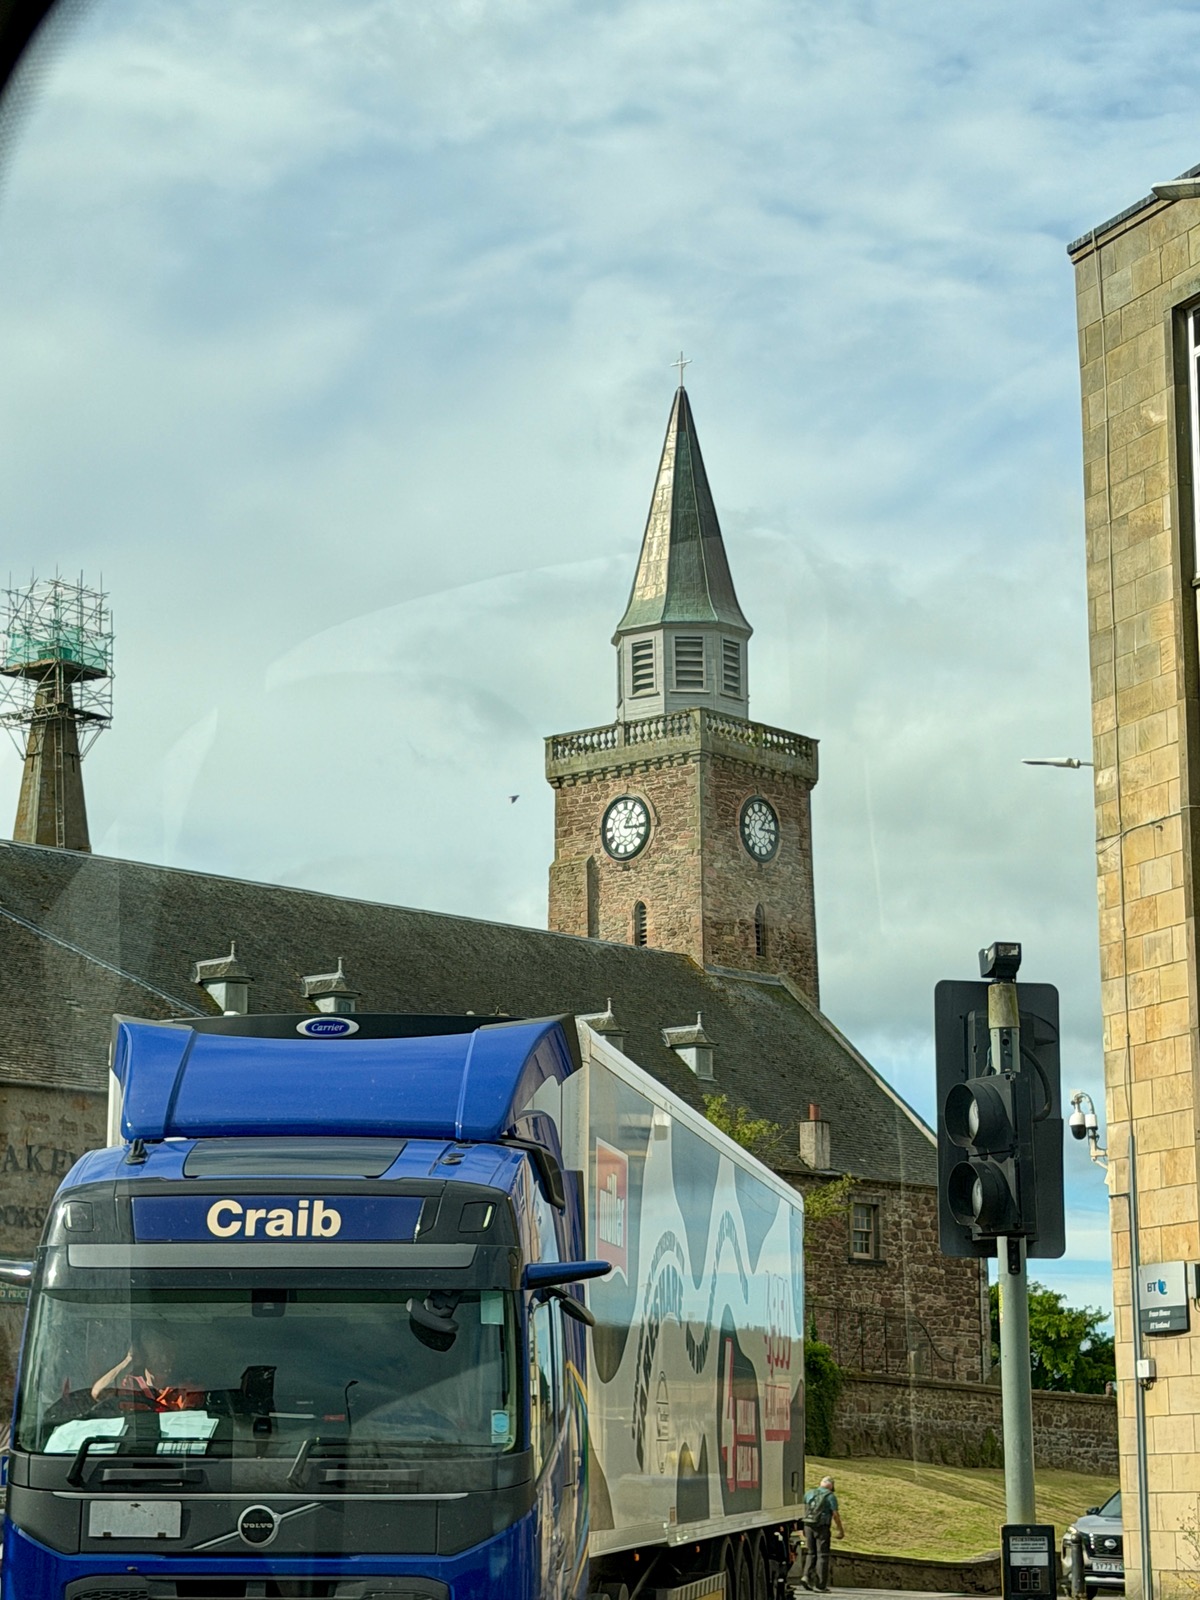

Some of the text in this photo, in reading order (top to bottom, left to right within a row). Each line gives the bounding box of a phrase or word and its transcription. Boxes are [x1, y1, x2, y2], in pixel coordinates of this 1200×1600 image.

[311, 1023, 345, 1031] Carrier
[206, 1199, 342, 1237] Craib
[1147, 1282, 1157, 1293] BT
